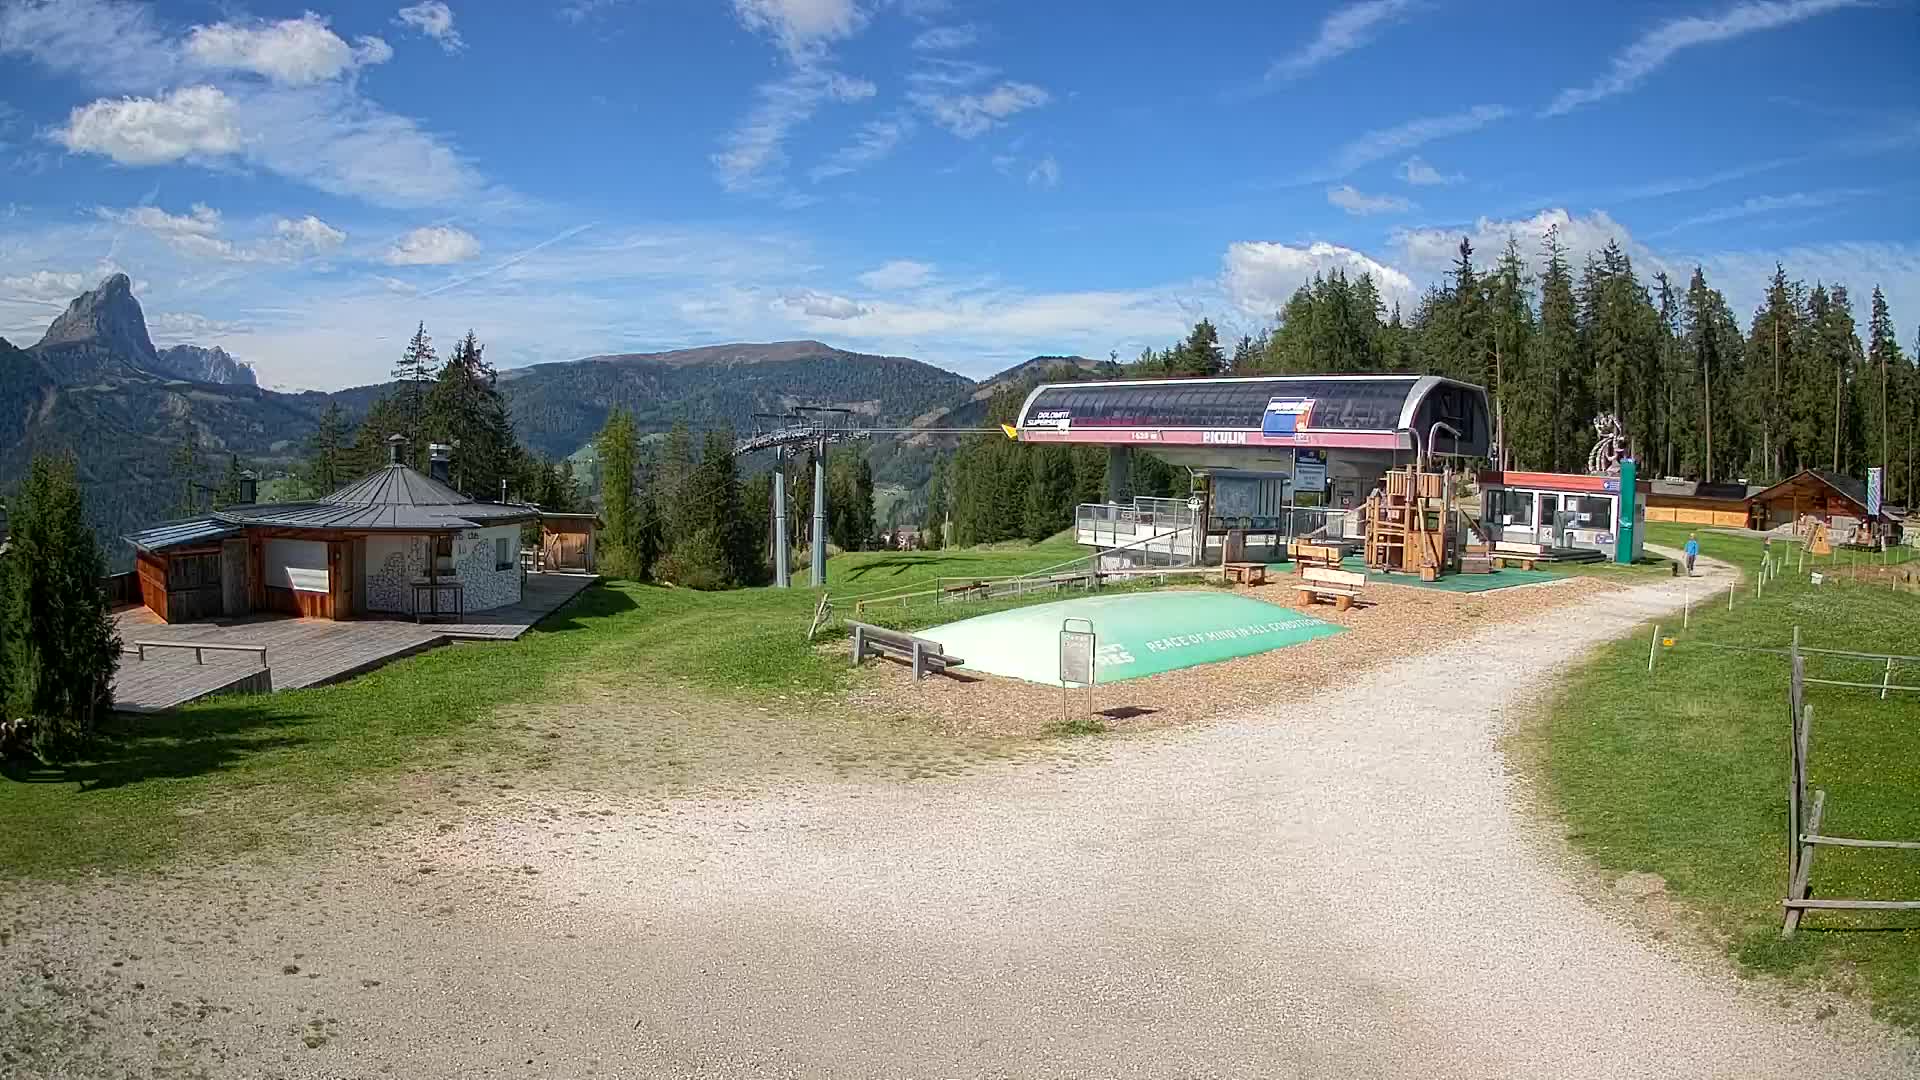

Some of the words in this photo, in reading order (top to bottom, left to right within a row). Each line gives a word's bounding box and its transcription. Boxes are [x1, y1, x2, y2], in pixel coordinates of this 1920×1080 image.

[1202, 431, 1247, 444] PICULIN
[1145, 635, 1190, 653] PEACE
[1191, 631, 1206, 645] OF
[1207, 628, 1236, 642] MIND
[1236, 626, 1250, 639] IN
[1250, 623, 1269, 636] ALL
[1271, 617, 1327, 632] CONDITIONS
